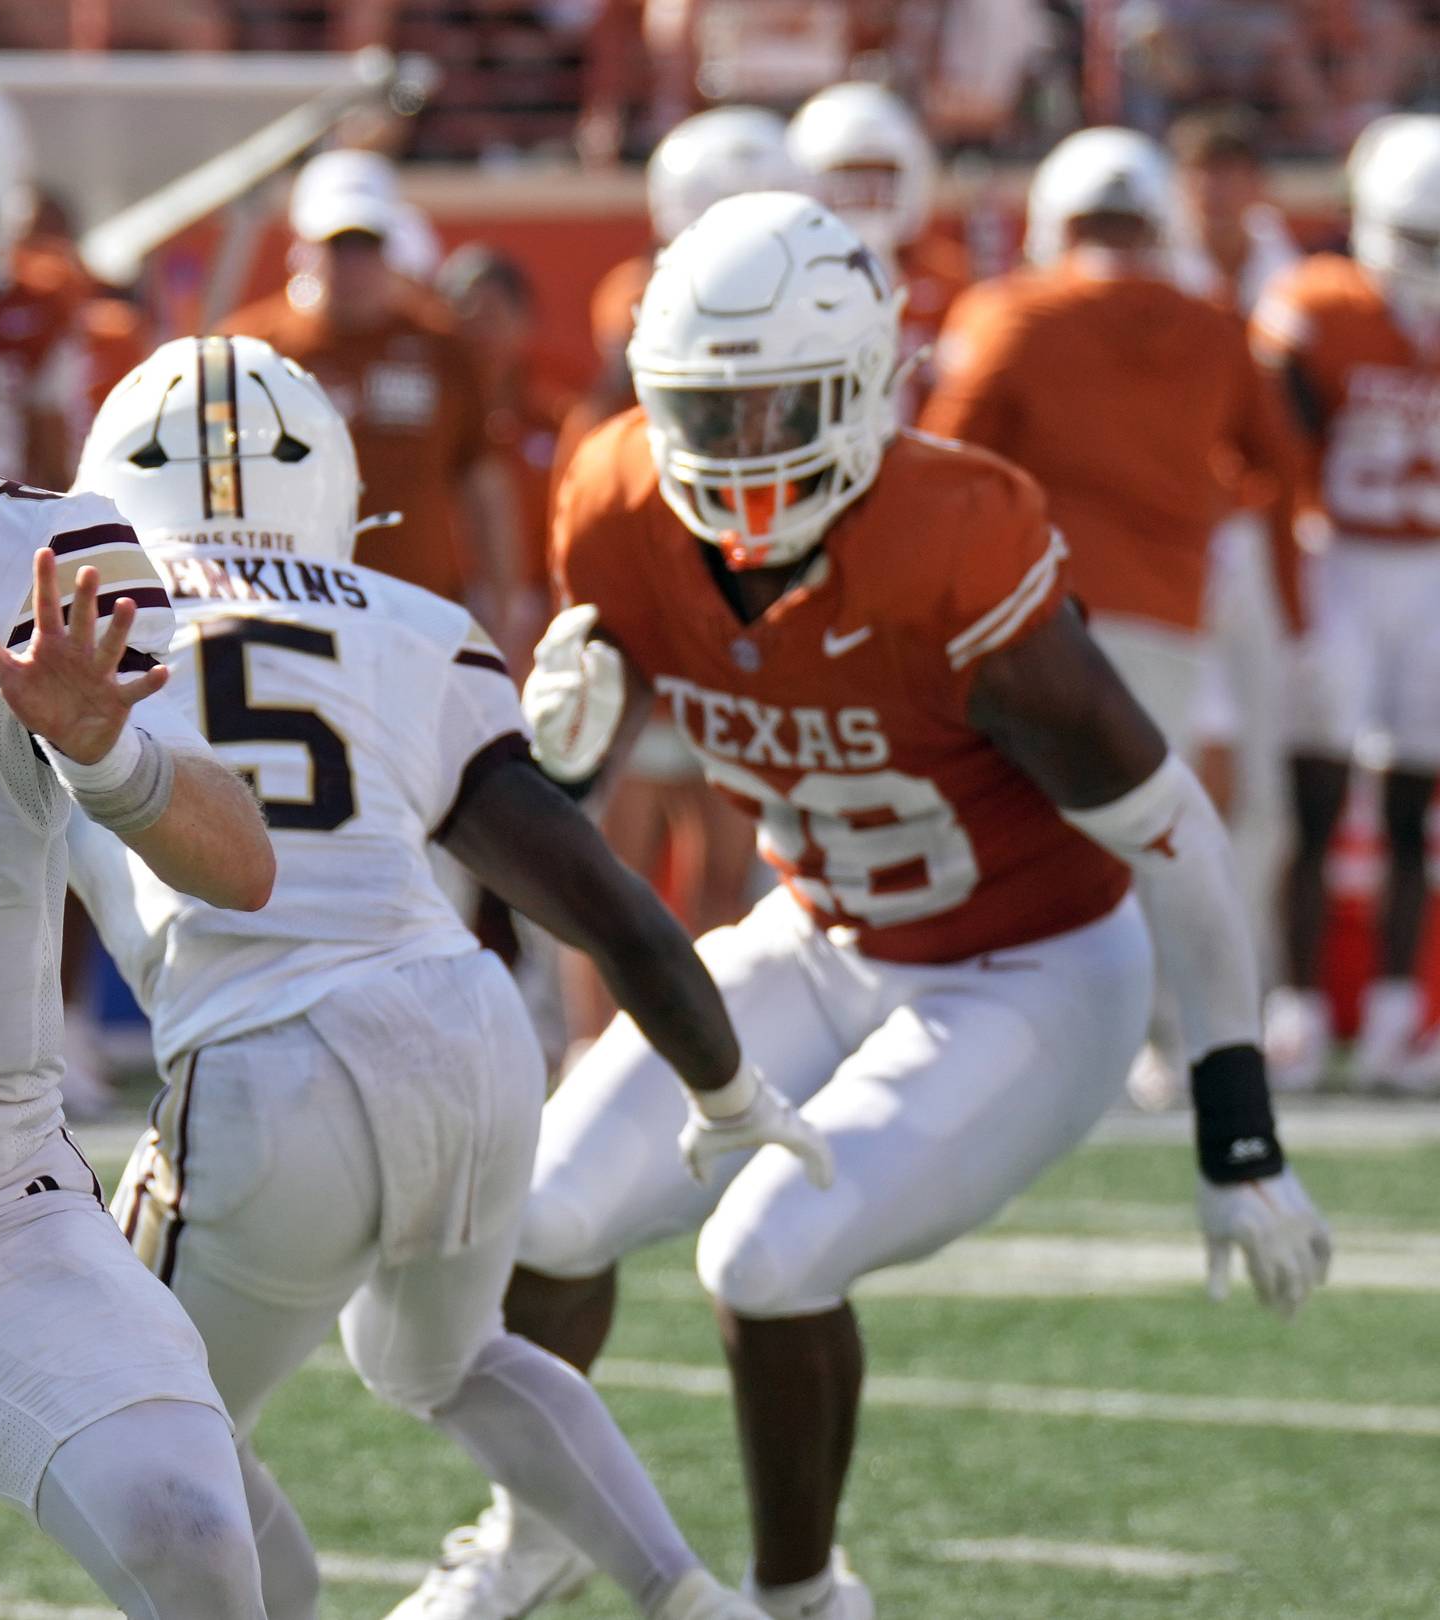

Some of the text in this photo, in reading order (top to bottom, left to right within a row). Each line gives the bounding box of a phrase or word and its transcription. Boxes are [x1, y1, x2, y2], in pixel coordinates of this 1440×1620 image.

[162, 558, 367, 609] ENKINS
[193, 613, 361, 833] 5
[654, 675, 891, 770] TEXAS
